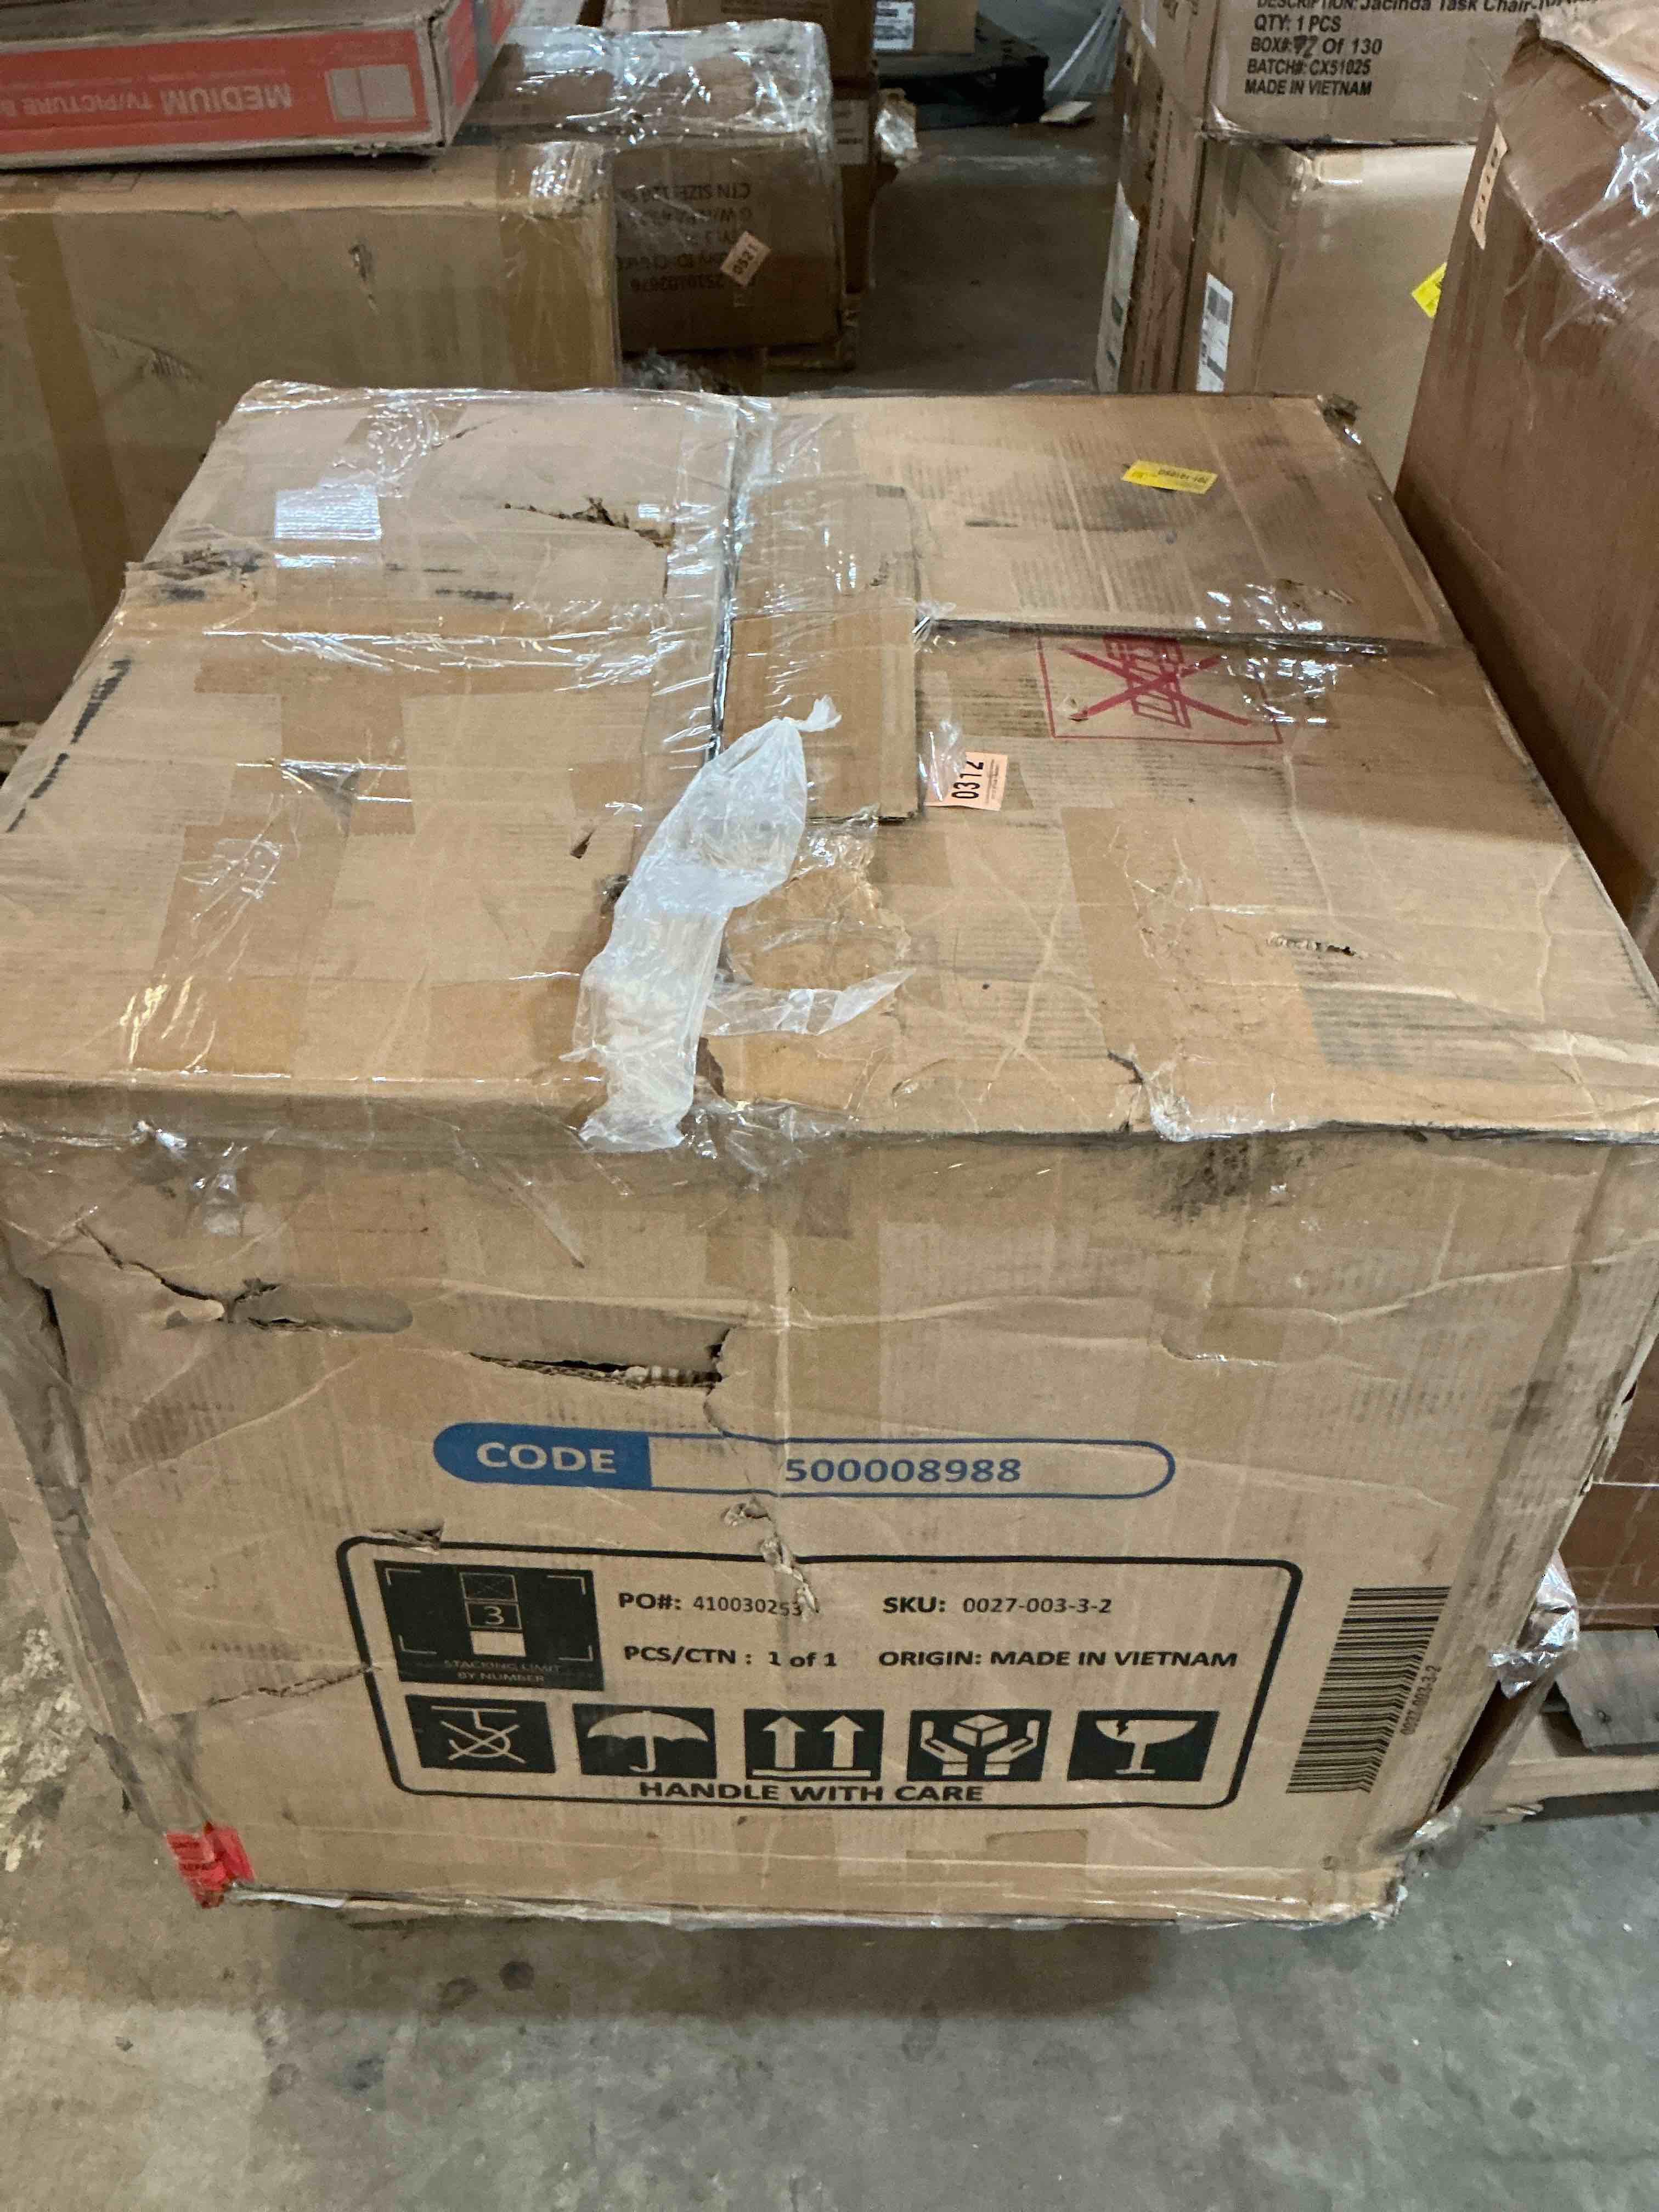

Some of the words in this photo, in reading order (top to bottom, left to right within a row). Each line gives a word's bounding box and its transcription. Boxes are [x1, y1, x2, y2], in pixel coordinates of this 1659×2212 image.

[1254, 14, 1290, 31] QTY:
[1297, 15, 1304, 31] 1
[1308, 15, 1342, 32] PCS
[1352, 37, 1383, 55] 130
[1308, 59, 1372, 75] CX51025
[1244, 79, 1287, 95] MADE
[1290, 80, 1304, 95] IN
[1308, 80, 1372, 96] VIETNAM
[160, 82, 292, 115] MEDIUM
[476, 1442, 617, 1474] CODE
[785, 1457, 1022, 1483] 500008988
[618, 1592, 681, 1611] PO#:
[882, 1596, 946, 1614] SKU:
[962, 1597, 1113, 1614] 0027-003-3-2
[483, 1605, 505, 1625] 3
[768, 1651, 782, 1666] 1
[789, 1652, 817, 1668] of
[825, 1652, 837, 1667] 1
[878, 1651, 981, 1666] ORIGIN:
[990, 1651, 1070, 1666] MADE
[1078, 1651, 1106, 1666] IN
[1114, 1651, 1238, 1667] VIETNAM
[480, 1672, 545, 1682] NUMBER
[640, 1781, 778, 1802] HANDLE
[789, 1786, 883, 1802] WITH
[895, 1786, 984, 1802] CARE
